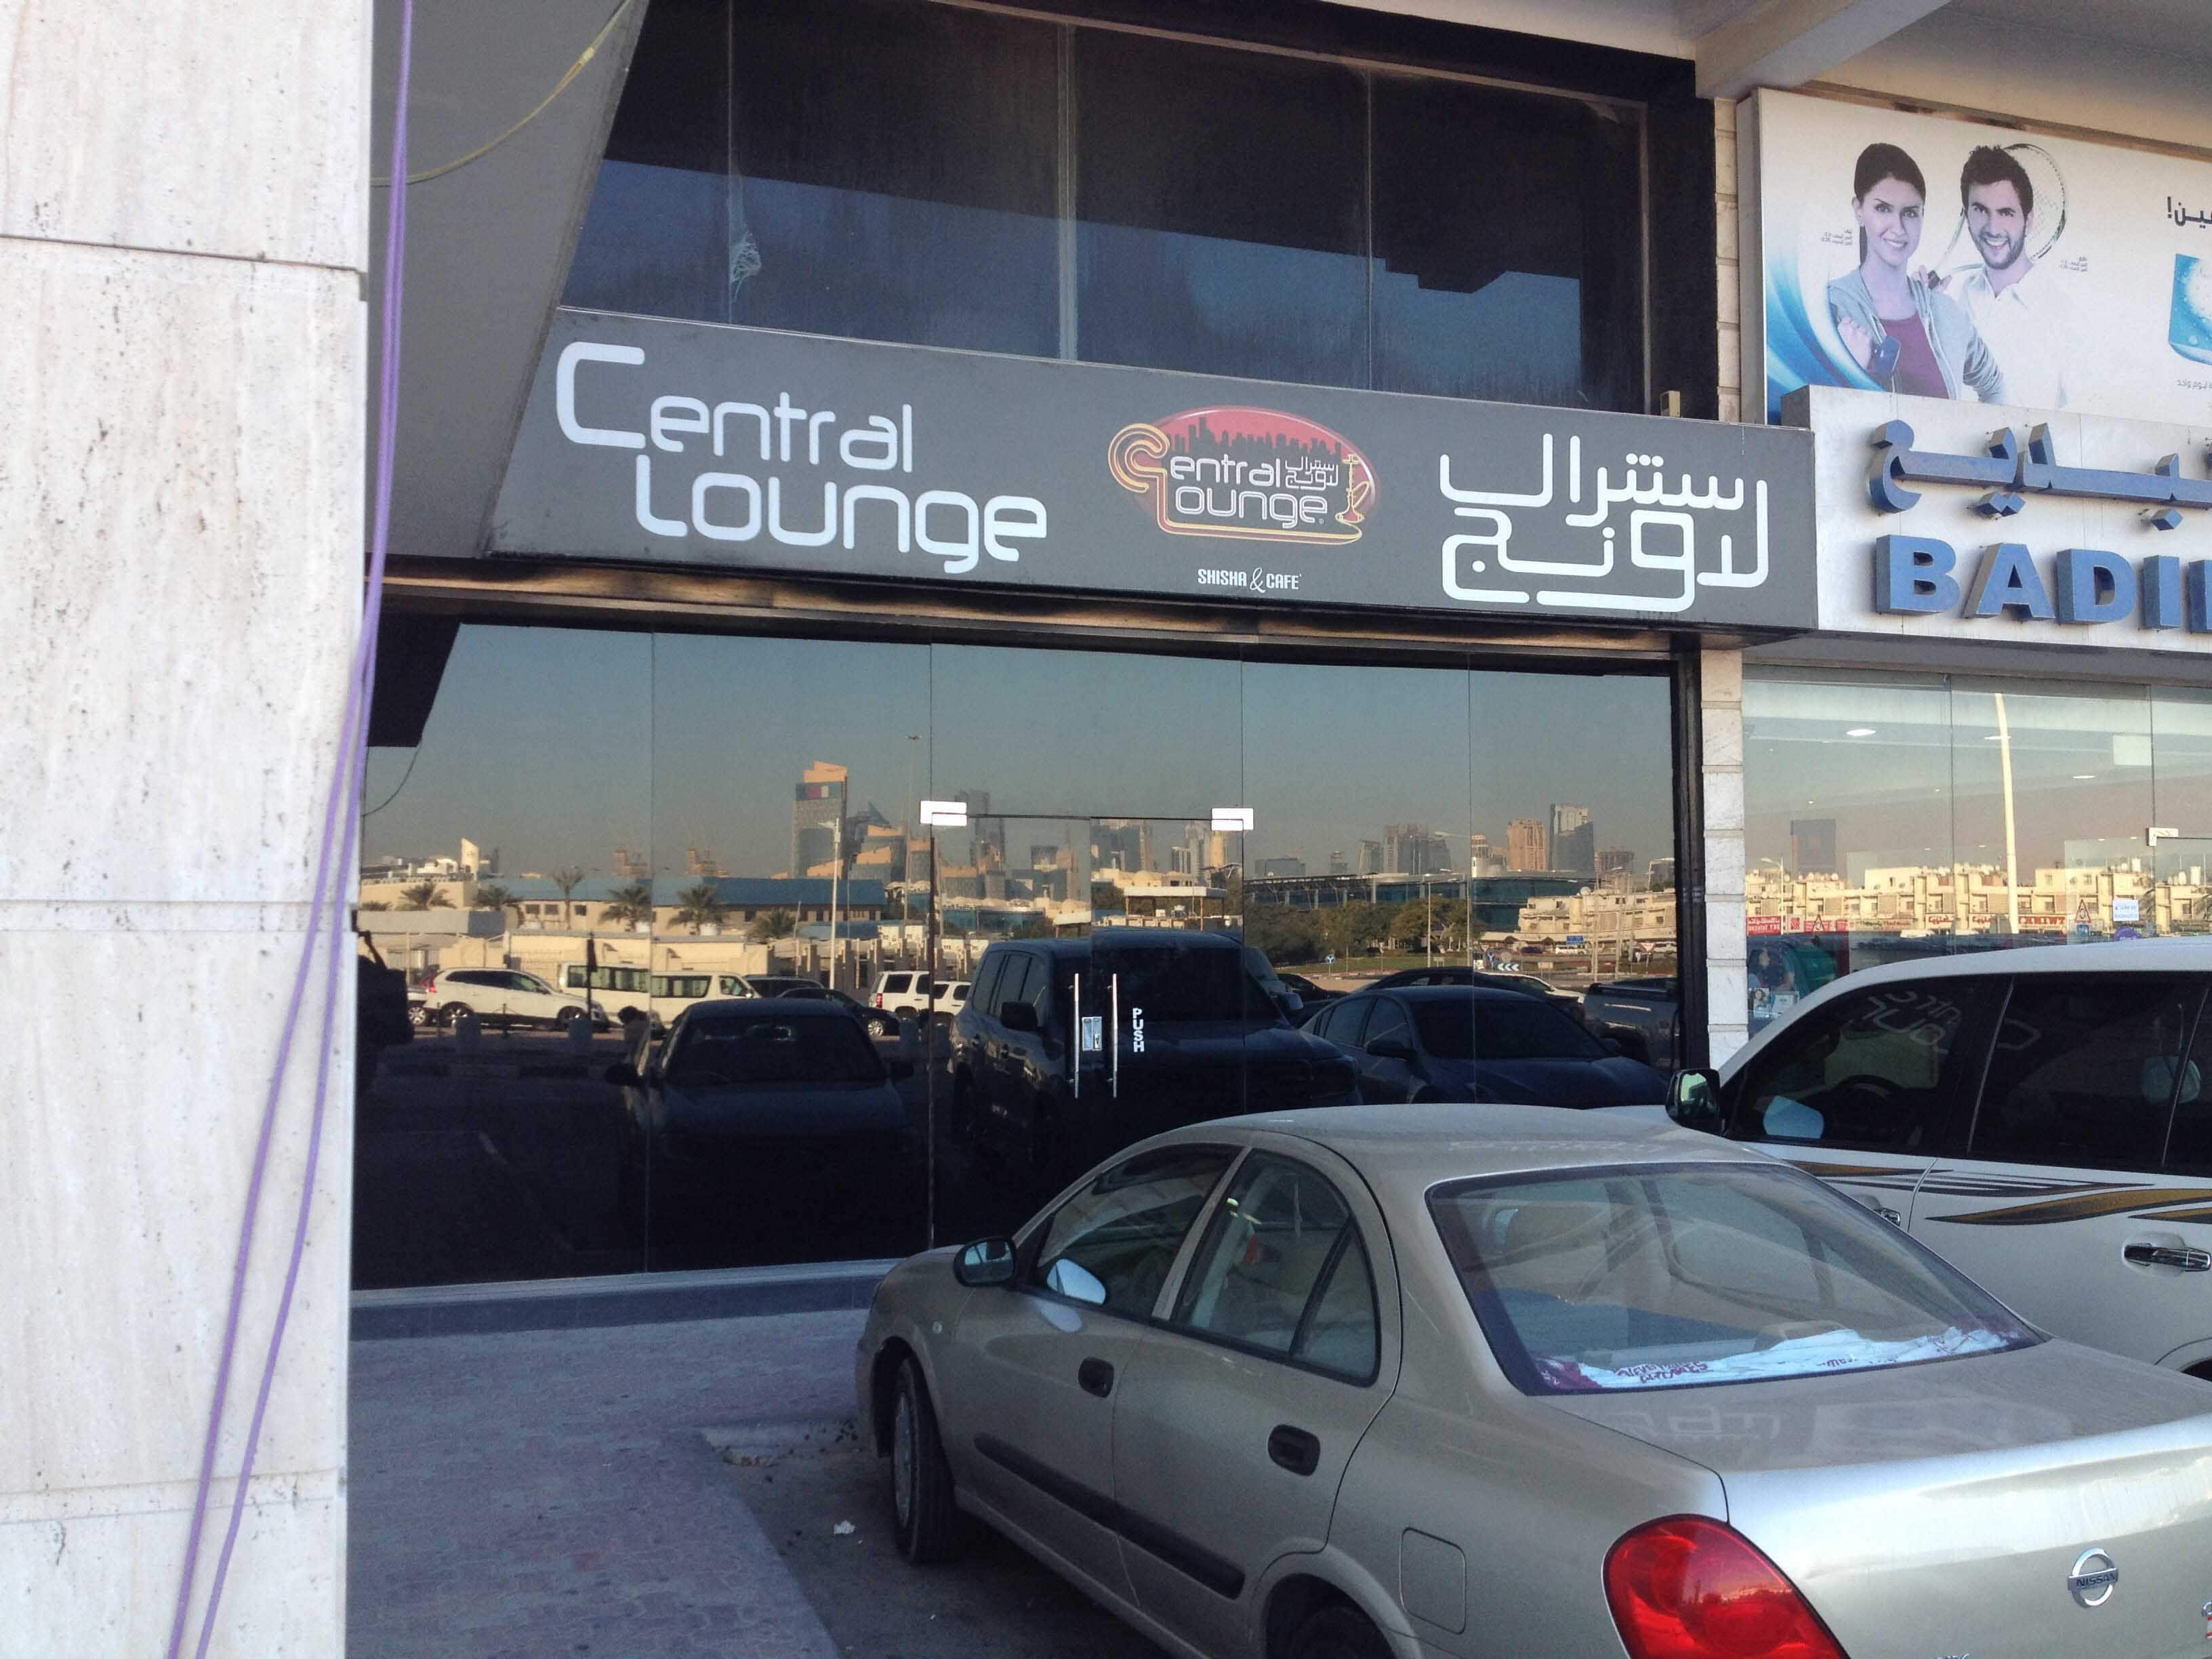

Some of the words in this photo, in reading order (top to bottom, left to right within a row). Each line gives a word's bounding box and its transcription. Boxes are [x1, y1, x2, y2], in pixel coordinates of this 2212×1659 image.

[556, 341, 913, 473] Central
[635, 454, 1048, 574] Lounge
[1197, 569, 1248, 587] SHISHA
[1250, 567, 1266, 594] &
[1132, 1007, 1145, 1052] PUSH
[2076, 1572, 2116, 1587] NISSAN
